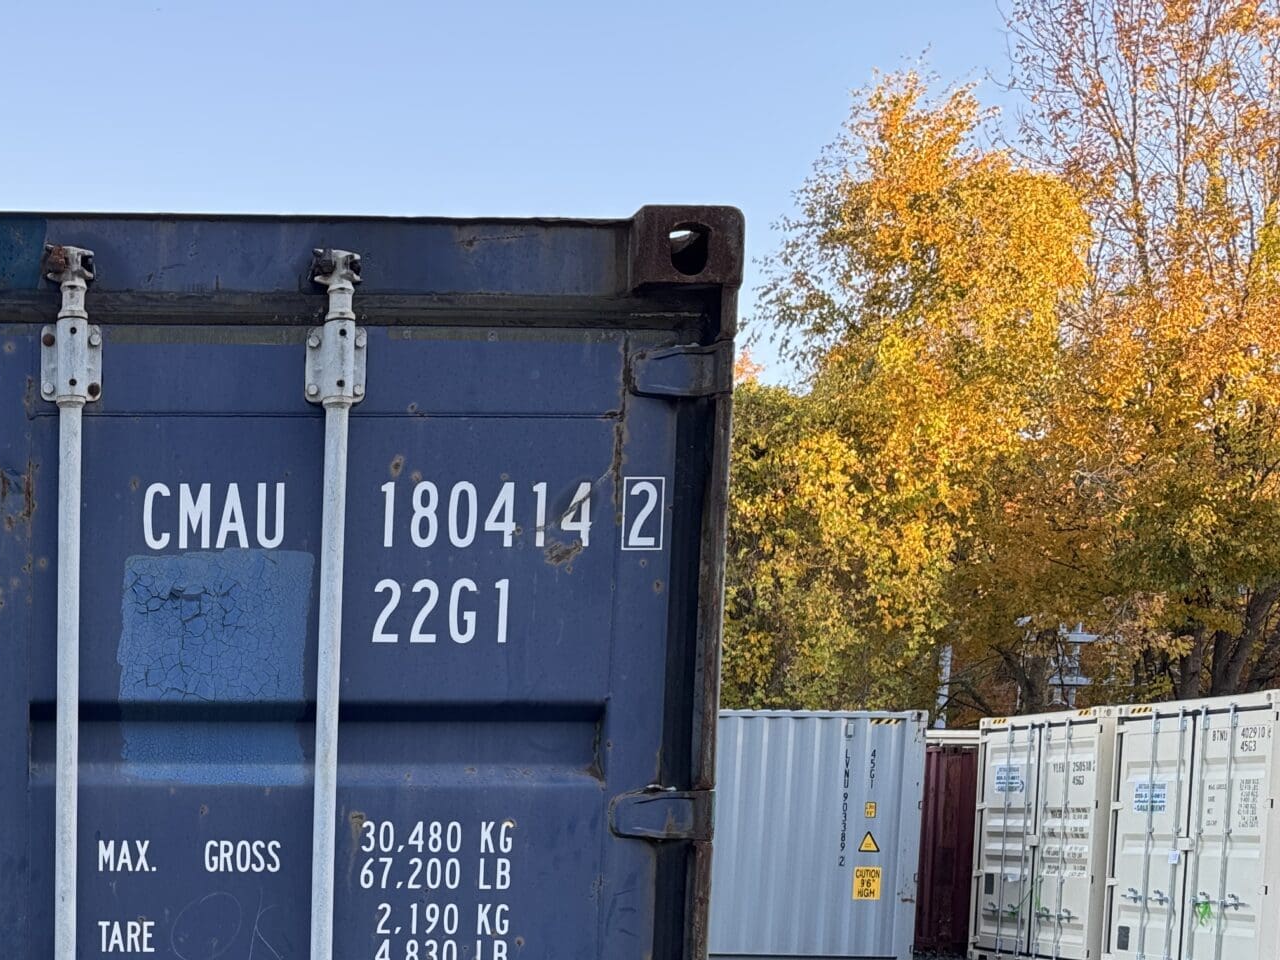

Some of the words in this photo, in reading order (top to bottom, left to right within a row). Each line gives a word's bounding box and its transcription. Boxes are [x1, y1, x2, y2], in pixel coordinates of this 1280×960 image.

[143, 482, 286, 549] CMAU
[380, 481, 593, 549] 180414
[627, 481, 658, 548] 2
[372, 578, 509, 644] 22G1
[361, 821, 462, 855] 30,480
[480, 821, 514, 854] KG
[98, 840, 158, 873] MAX.
[204, 840, 282, 873] GROSS
[855, 869, 881, 878] CAUTION
[359, 857, 461, 891] 67,200
[477, 857, 512, 891] LB
[857, 887, 876, 898] HIGH
[98, 920, 156, 953] TARE
[375, 903, 460, 937] 2,190
[476, 903, 510, 935] KG
